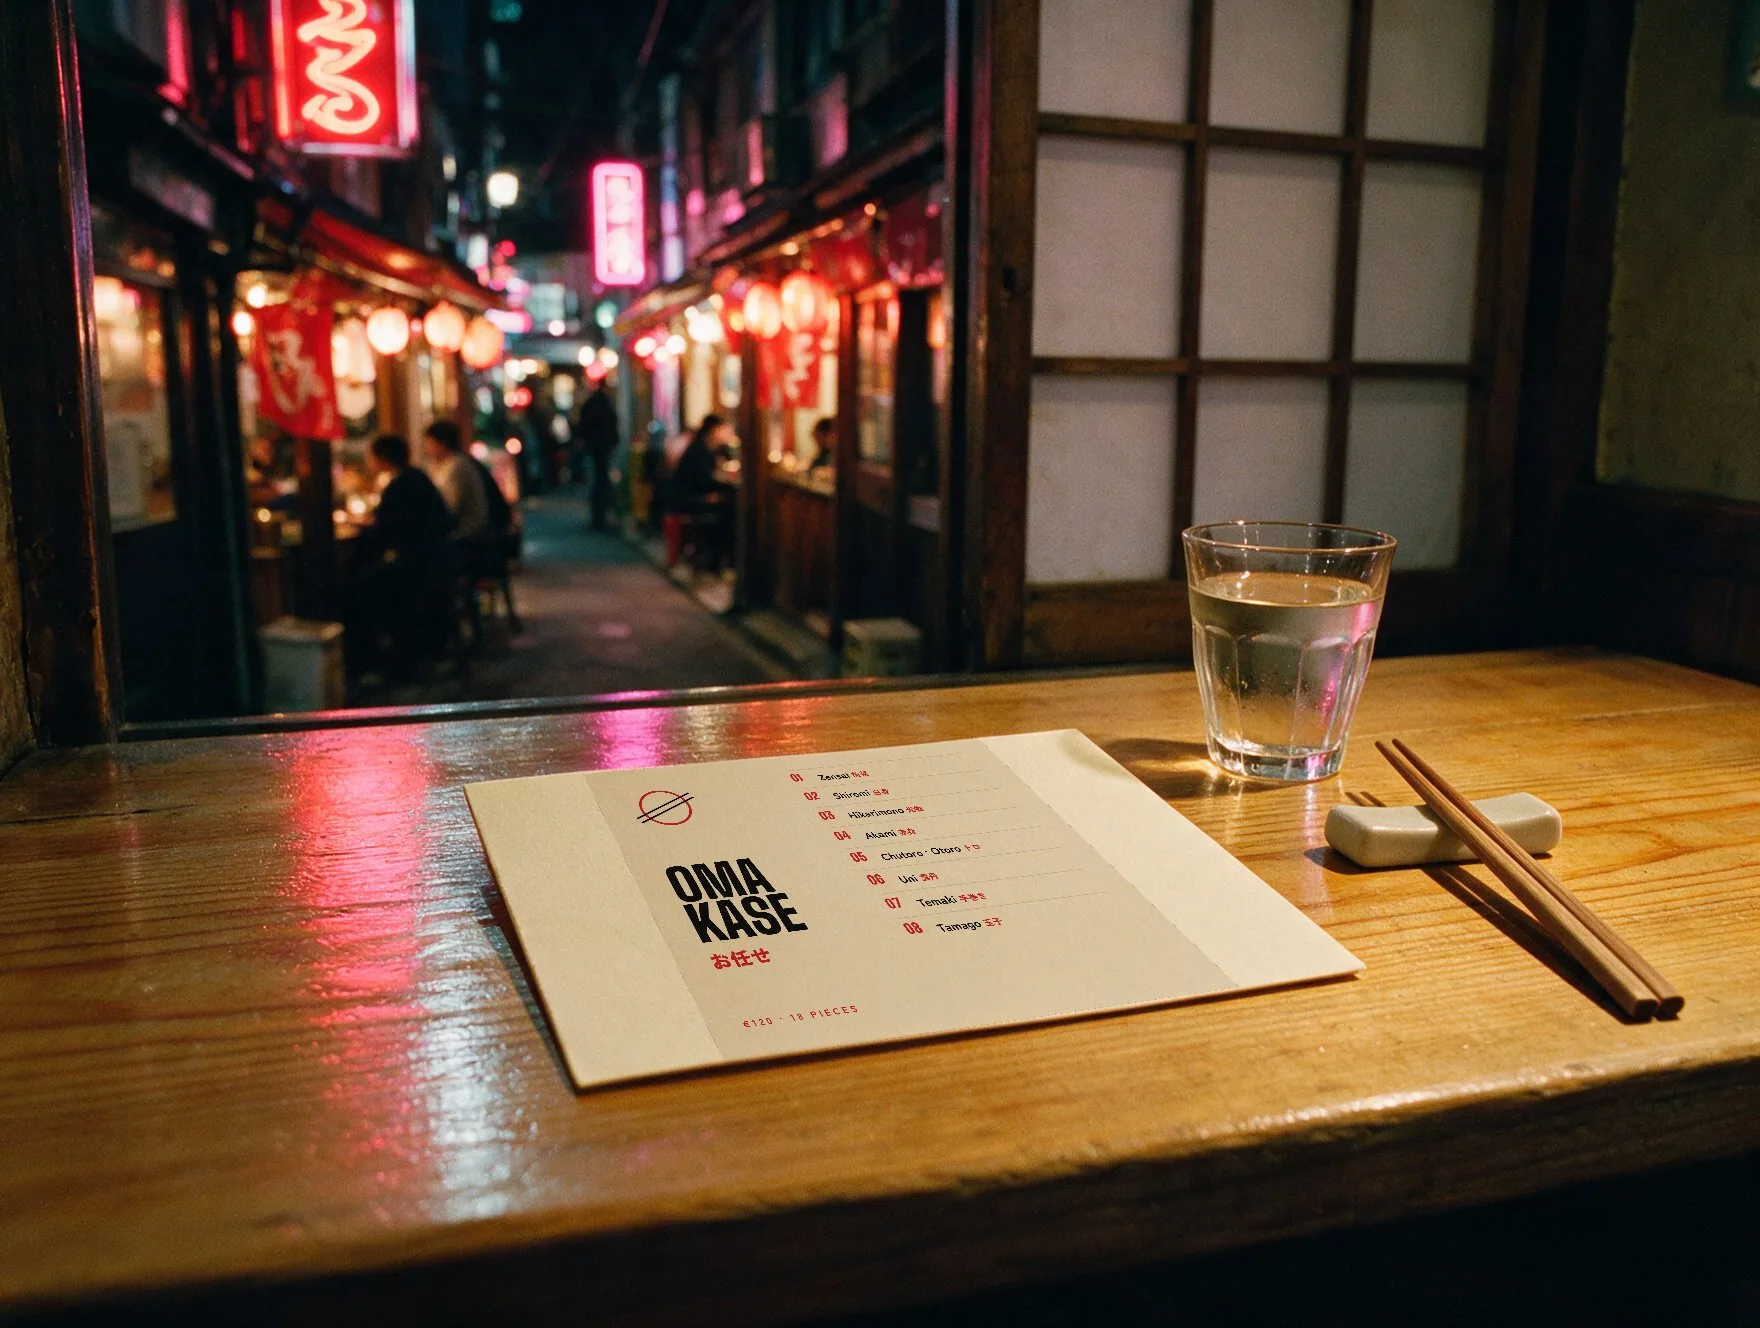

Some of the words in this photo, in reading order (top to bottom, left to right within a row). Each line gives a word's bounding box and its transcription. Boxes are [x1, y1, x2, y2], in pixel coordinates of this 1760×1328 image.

[790, 774, 804, 783] 01
[817, 772, 851, 781] Zensai
[803, 791, 820, 801] 02
[833, 789, 871, 800] Shiromi
[818, 810, 836, 821] 03
[848, 807, 905, 819] Hikarimono
[833, 830, 852, 841] 04
[866, 829, 897, 840] Akami
[849, 851, 868, 863] 05
[881, 850, 924, 861] Chutoro
[931, 846, 962, 855] Otoro
[964, 844, 980, 852] トロ
[666, 858, 777, 903] OMA
[866, 874, 886, 886] 06
[898, 874, 919, 884] Uni
[884, 897, 902, 909] 07
[916, 895, 958, 908] Temaki
[683, 893, 809, 943] KASE
[903, 921, 924, 935] 08
[936, 919, 982, 933] Tamago
[710, 947, 771, 970] お任せ
[742, 1017, 773, 1028] €120
[790, 1012, 804, 1021] 18
[809, 1005, 859, 1018] PIECES
